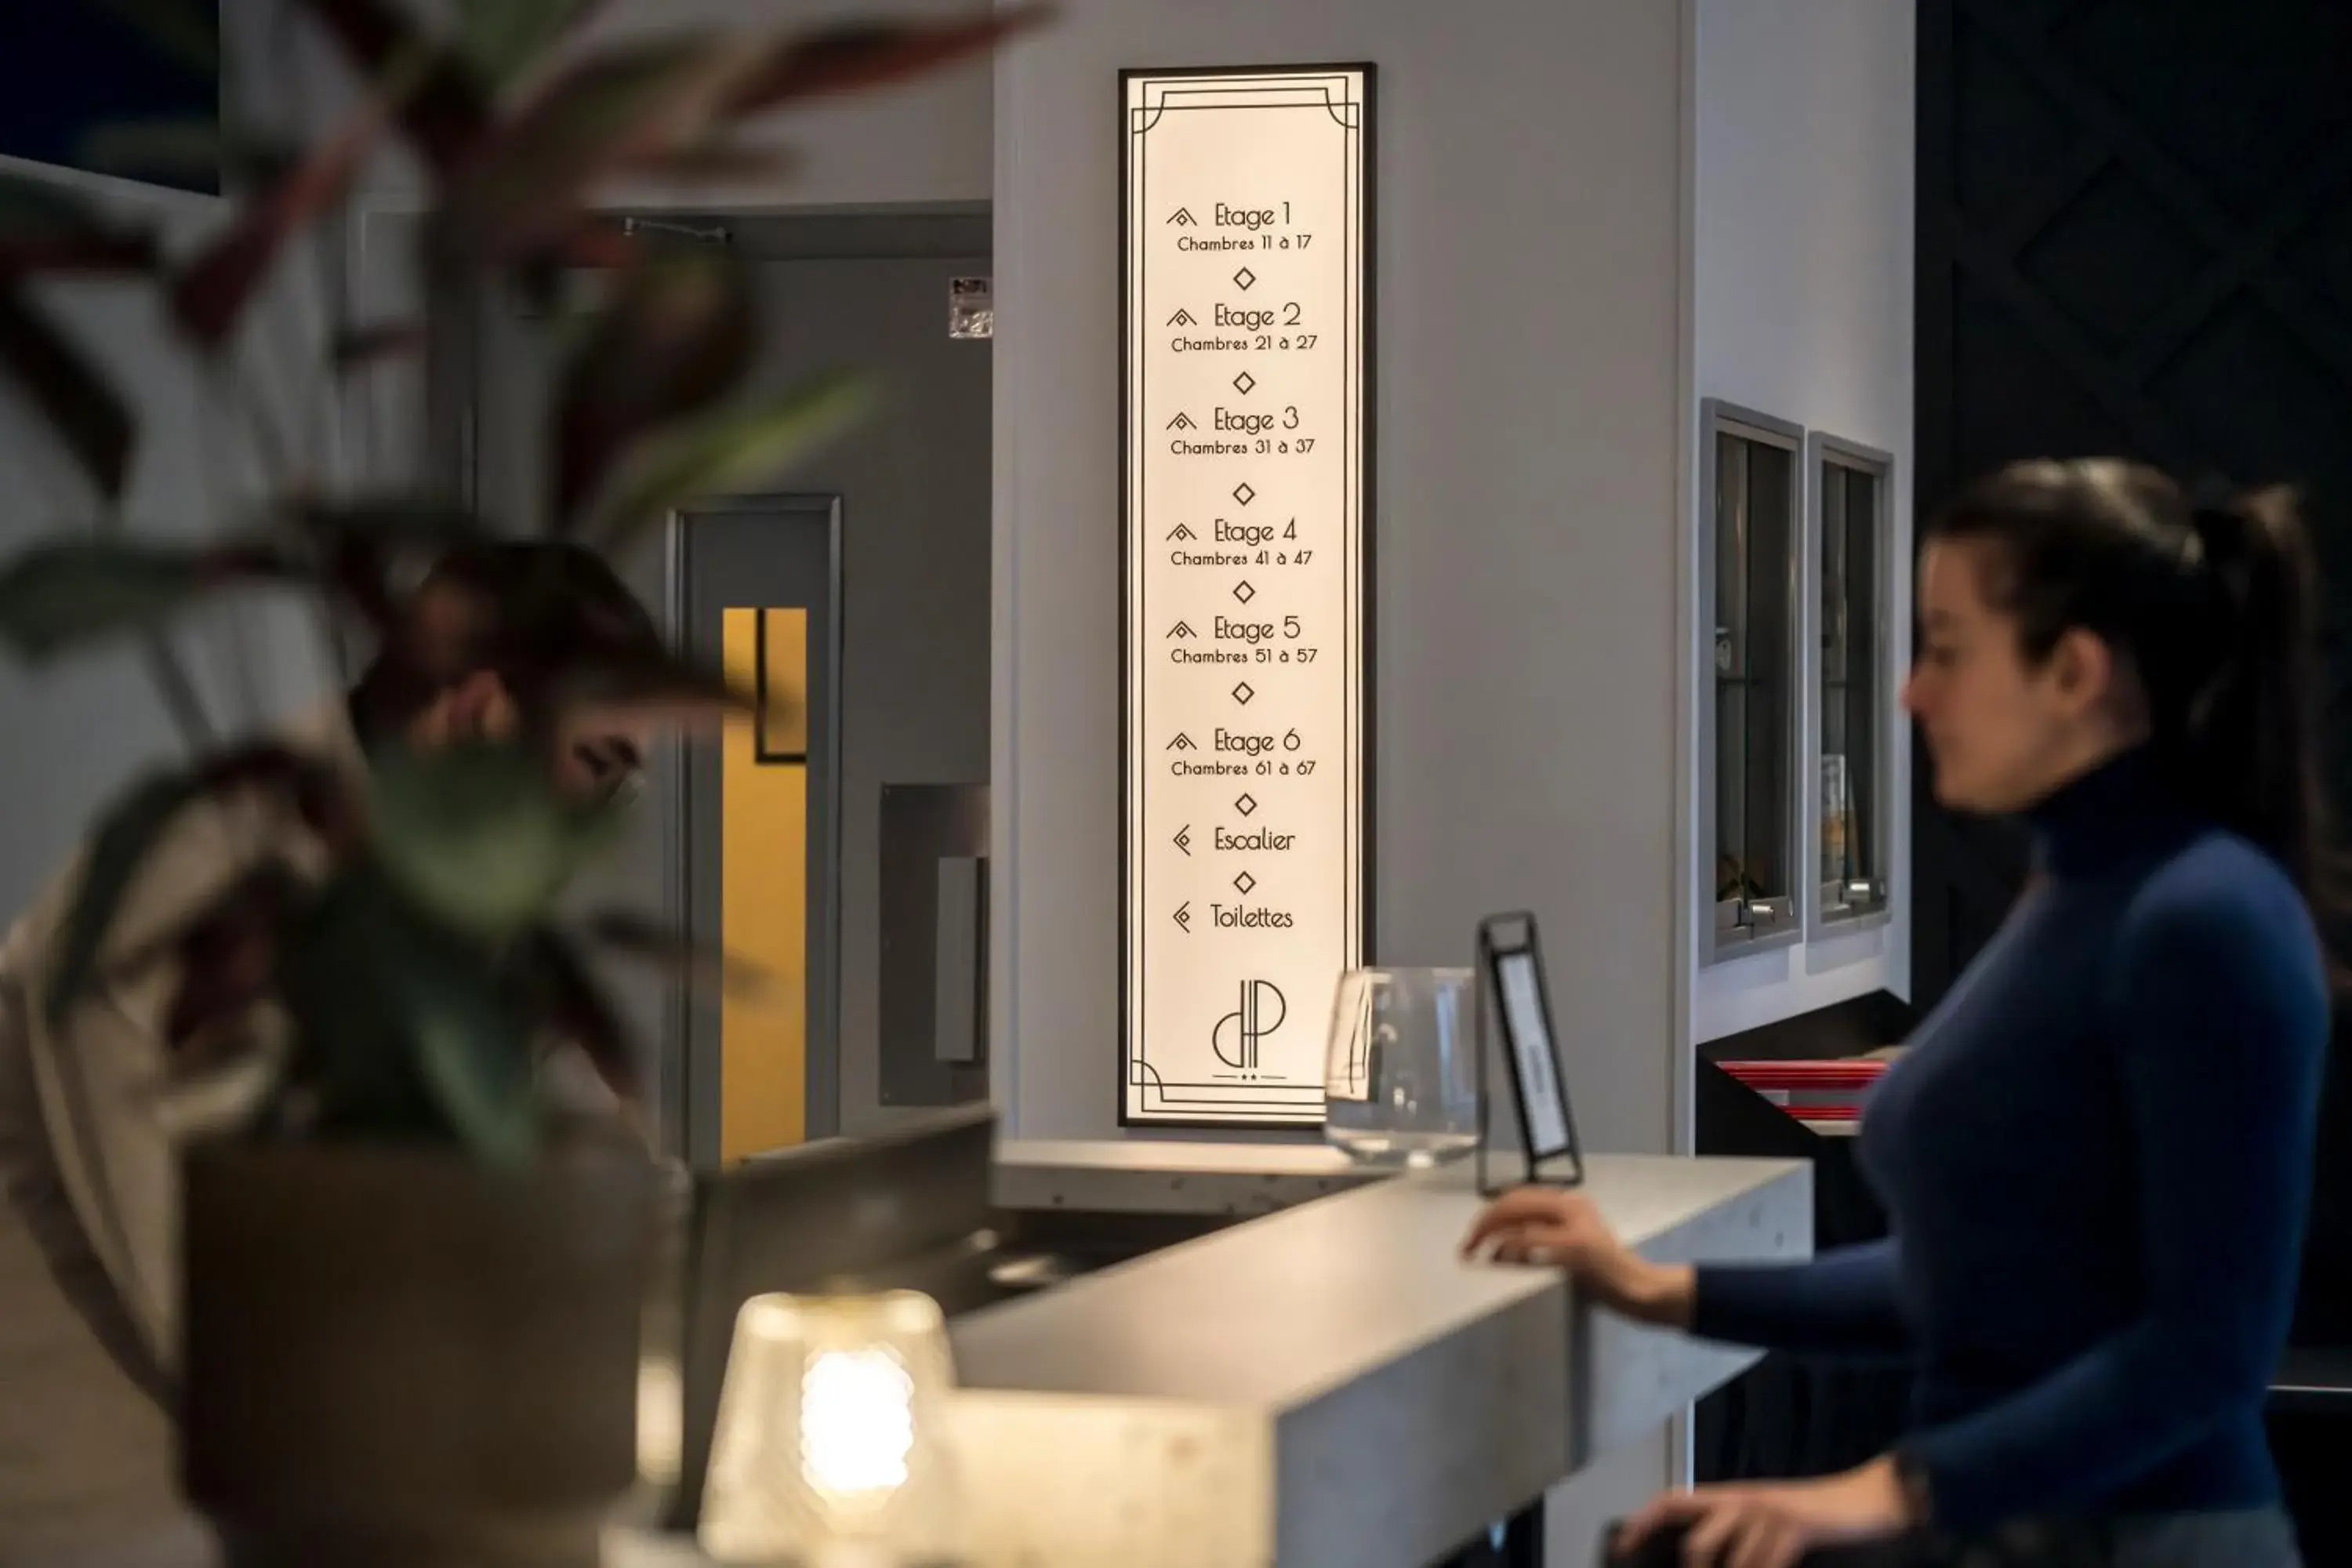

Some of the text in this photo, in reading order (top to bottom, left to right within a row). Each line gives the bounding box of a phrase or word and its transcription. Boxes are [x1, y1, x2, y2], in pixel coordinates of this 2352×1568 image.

[1216, 201, 1290, 230] Etage 1
[1177, 234, 1312, 252] Chambres 11 à 17
[1214, 302, 1301, 332] Etage 2
[1171, 335, 1318, 352] Chambres 21 à 27
[1214, 406, 1300, 436] Etage 3
[1171, 438, 1316, 455] Chambres 31 à 37
[1214, 517, 1298, 547] Etage 4
[1171, 550, 1313, 566] Chambres 41 à 47
[1214, 615, 1301, 644] Etage 5
[1171, 648, 1318, 663] Chambres 51 à 57
[1214, 728, 1301, 757] Etage 6
[1171, 760, 1316, 776] Chambres 61 à 67
[1214, 826, 1296, 851] Escalier
[1210, 904, 1294, 928] Toilettes
